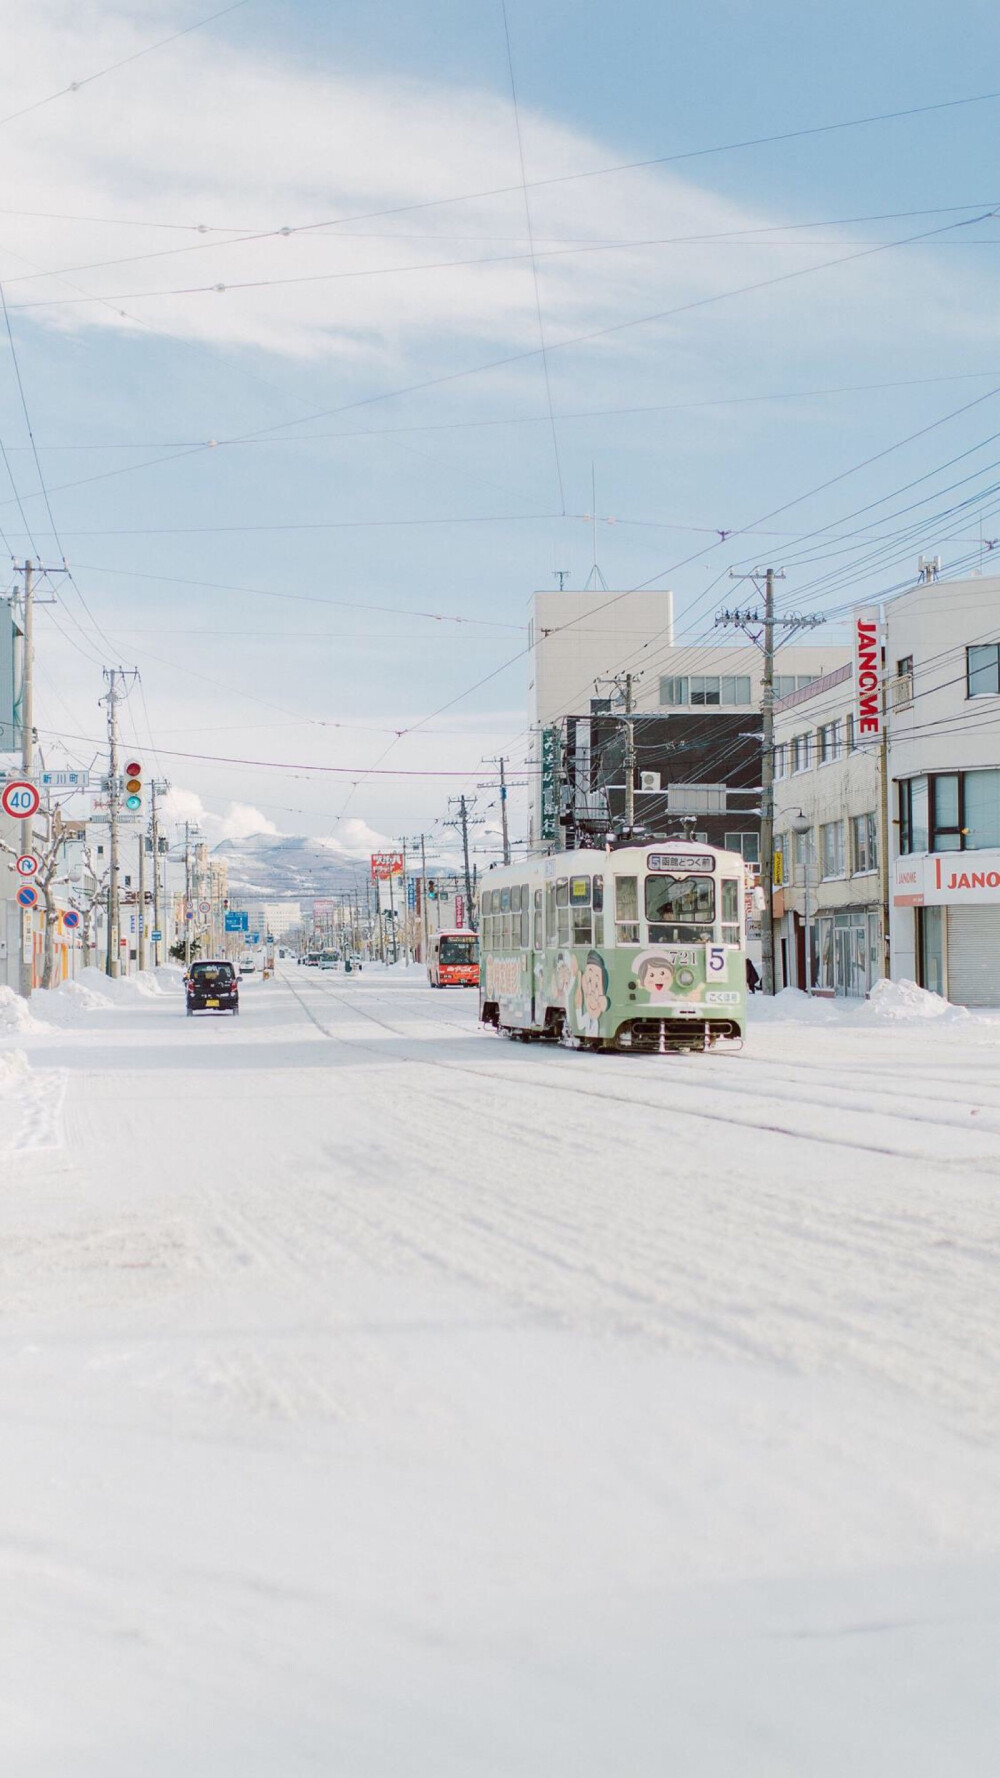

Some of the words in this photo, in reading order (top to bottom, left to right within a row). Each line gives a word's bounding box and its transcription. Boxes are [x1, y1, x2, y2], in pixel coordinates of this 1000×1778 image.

[857, 618, 879, 734] JANOME
[10, 791, 31, 809] 40
[898, 871, 917, 885] JANOME
[669, 951, 696, 965] 721
[709, 947, 725, 971] 5
